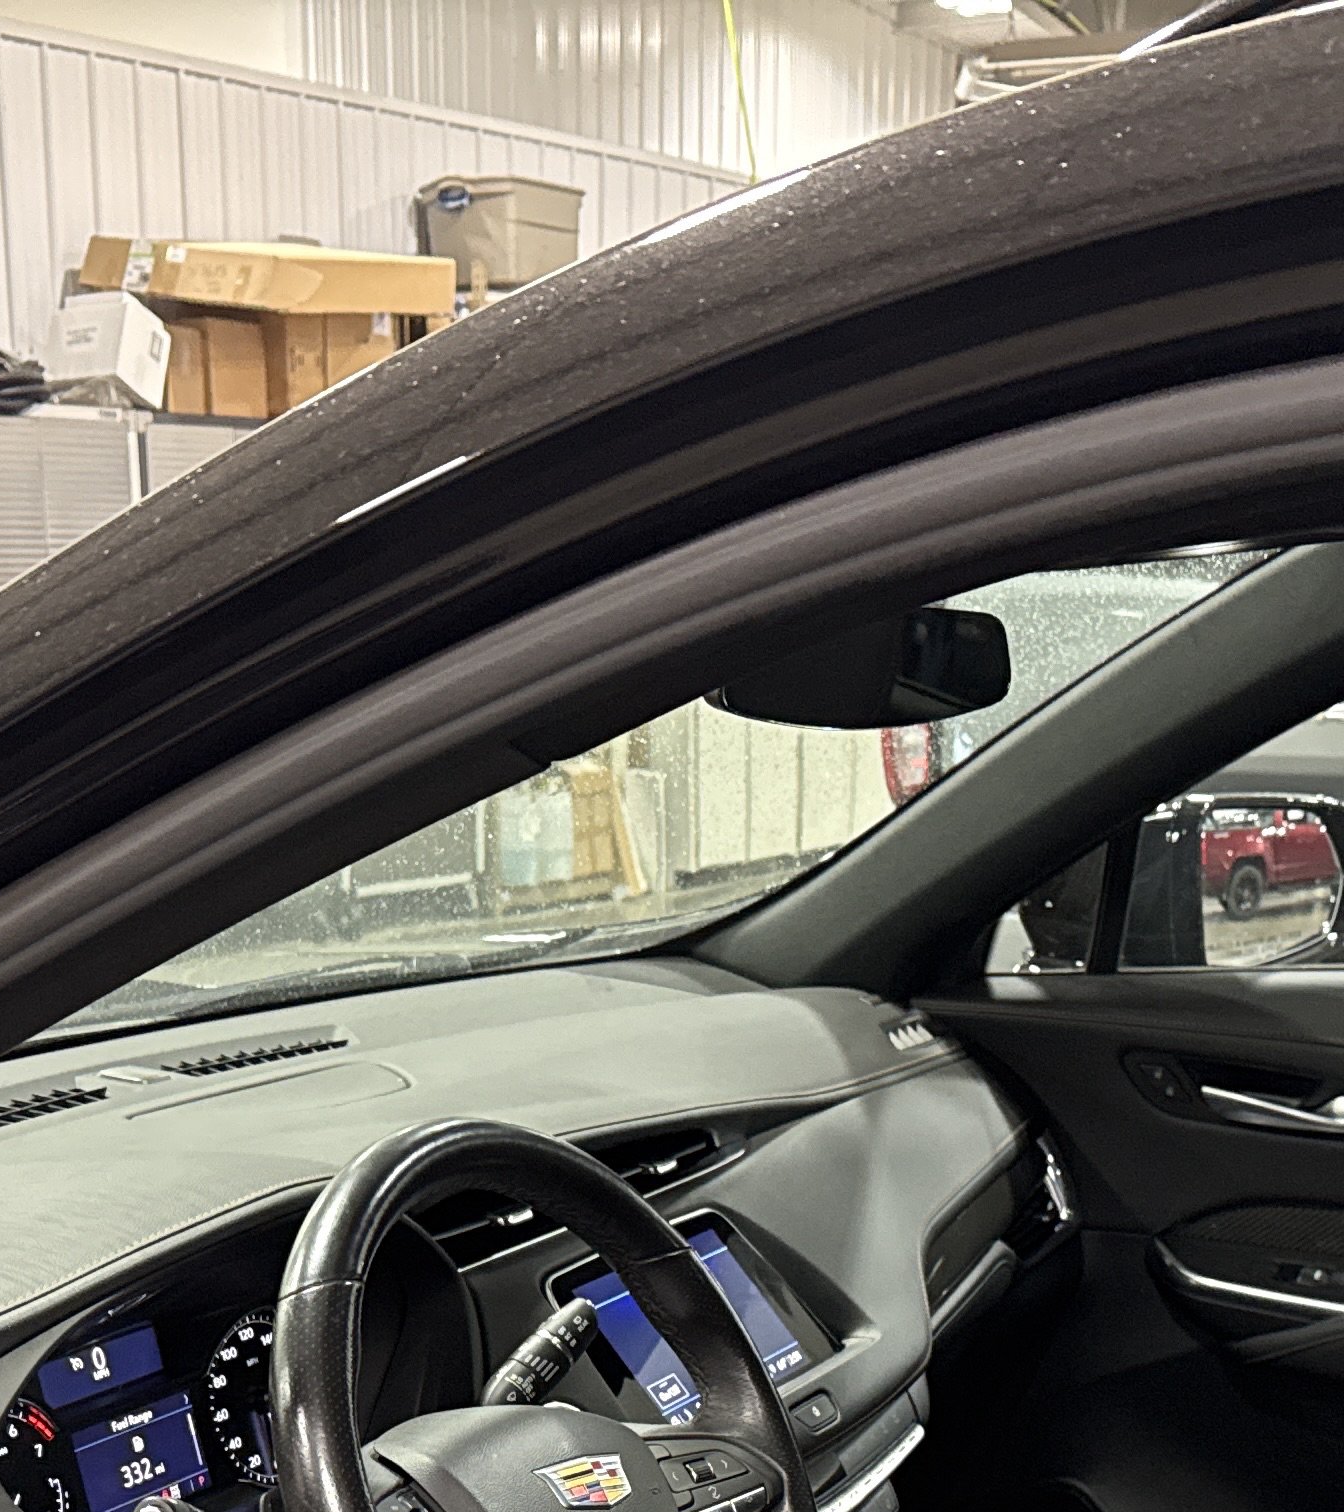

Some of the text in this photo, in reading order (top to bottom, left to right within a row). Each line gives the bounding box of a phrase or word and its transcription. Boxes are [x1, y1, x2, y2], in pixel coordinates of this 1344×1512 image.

[238, 1327, 254, 1341] 120
[91, 1346, 107, 1371] 0
[220, 1346, 238, 1361] 100
[93, 1368, 110, 1380] MPH
[213, 1374, 227, 1388] 80
[111, 1410, 153, 1432] Fuel Range
[216, 1408, 229, 1422] 60
[8, 1423, 19, 1438] 6
[229, 1436, 243, 1450] 40
[34, 1443, 43, 1458] 7
[248, 1454, 261, 1468] 20
[120, 1457, 154, 1488] 332
